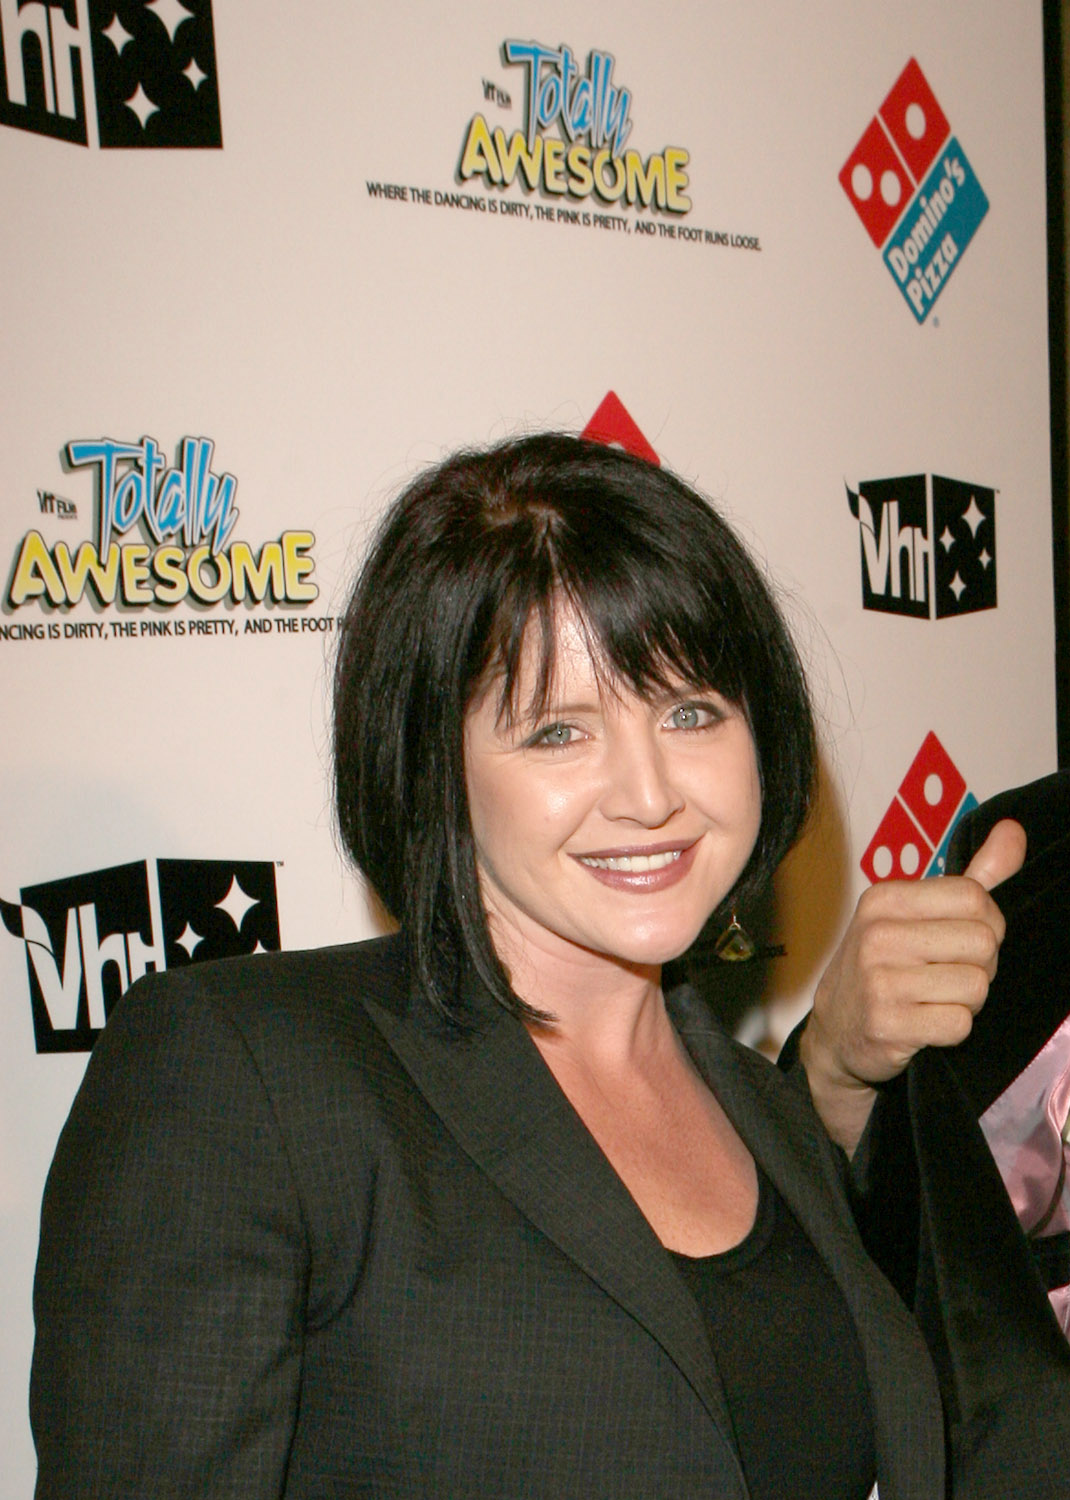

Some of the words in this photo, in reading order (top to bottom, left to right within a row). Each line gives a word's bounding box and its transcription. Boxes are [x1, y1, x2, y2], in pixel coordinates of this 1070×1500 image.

[502, 38, 633, 160] Totally
[456, 113, 693, 216] AWESOME
[366, 181, 407, 201] WHERE
[409, 187, 432, 206] THE
[434, 191, 486, 213] DANCING
[488, 198, 498, 213] IS
[500, 200, 534, 221] DIRTY,
[534, 205, 556, 222] THE
[557, 208, 581, 226] PINK
[582, 212, 591, 227] IS
[593, 214, 631, 234] PRETTY,
[634, 219, 656, 236] AND
[658, 223, 676, 239] THE
[678, 226, 703, 243] FOOT
[705, 230, 729, 246] RUNS
[886, 156, 966, 284] Domino's
[906, 232, 959, 317] Pizza
[62, 435, 240, 566] Totally
[7, 529, 320, 608] AWESOME
[0, 623, 45, 641] NCING
[48, 623, 60, 640] IS
[64, 621, 109, 641] DIRTY,
[110, 621, 138, 638] THE
[140, 620, 172, 637] PINK
[174, 620, 186, 636] IS
[189, 619, 239, 637] PRETTY,
[244, 618, 272, 634] AND
[274, 618, 299, 633] THE
[302, 617, 334, 632] FOOT
